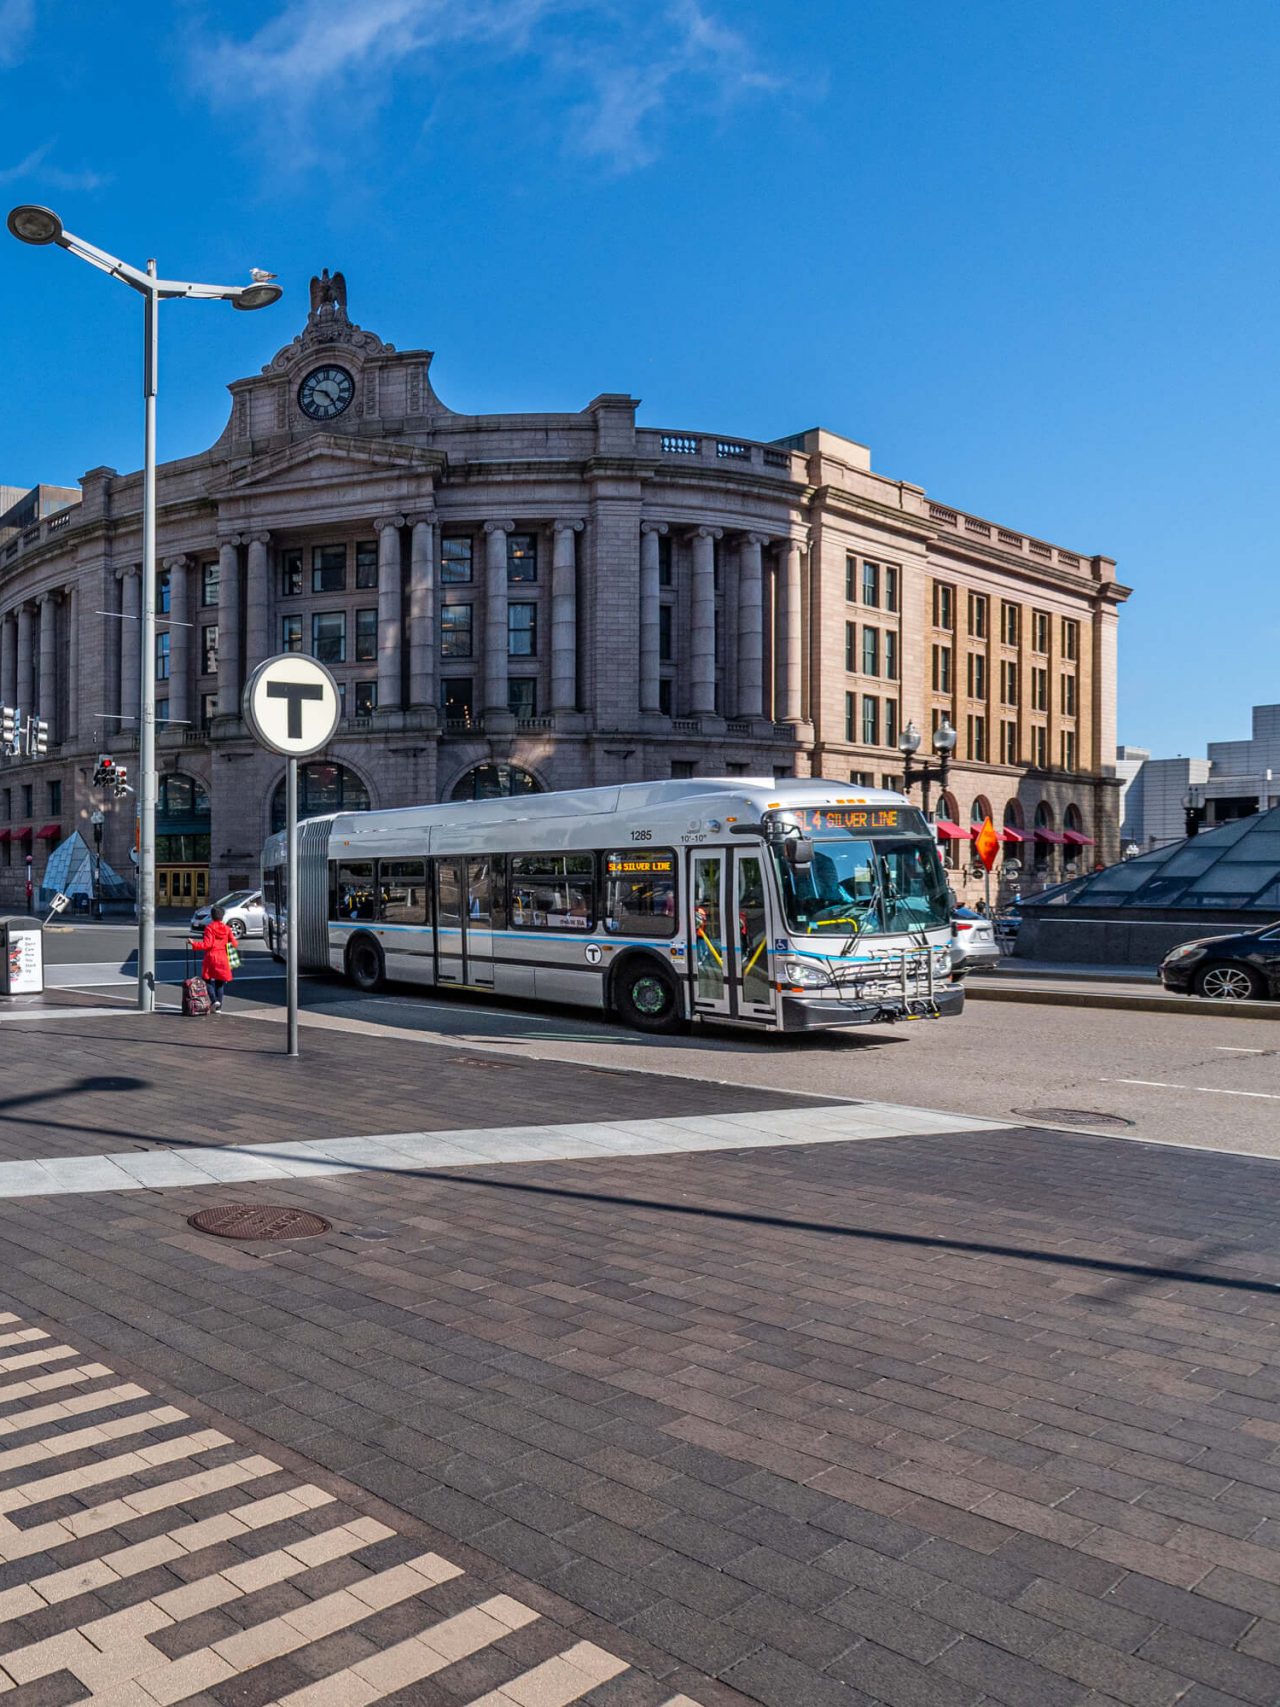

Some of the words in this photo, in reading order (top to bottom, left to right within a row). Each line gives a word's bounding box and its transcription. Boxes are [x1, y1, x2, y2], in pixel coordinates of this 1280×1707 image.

[266, 680, 324, 739] T
[826, 812, 867, 828] SILVER
[871, 811, 897, 827] LINE
[630, 829, 652, 841] 1285
[608, 862, 622, 871] SL4
[623, 862, 650, 871] SILVER
[652, 862, 671, 871] LINE
[587, 948, 599, 961] T
